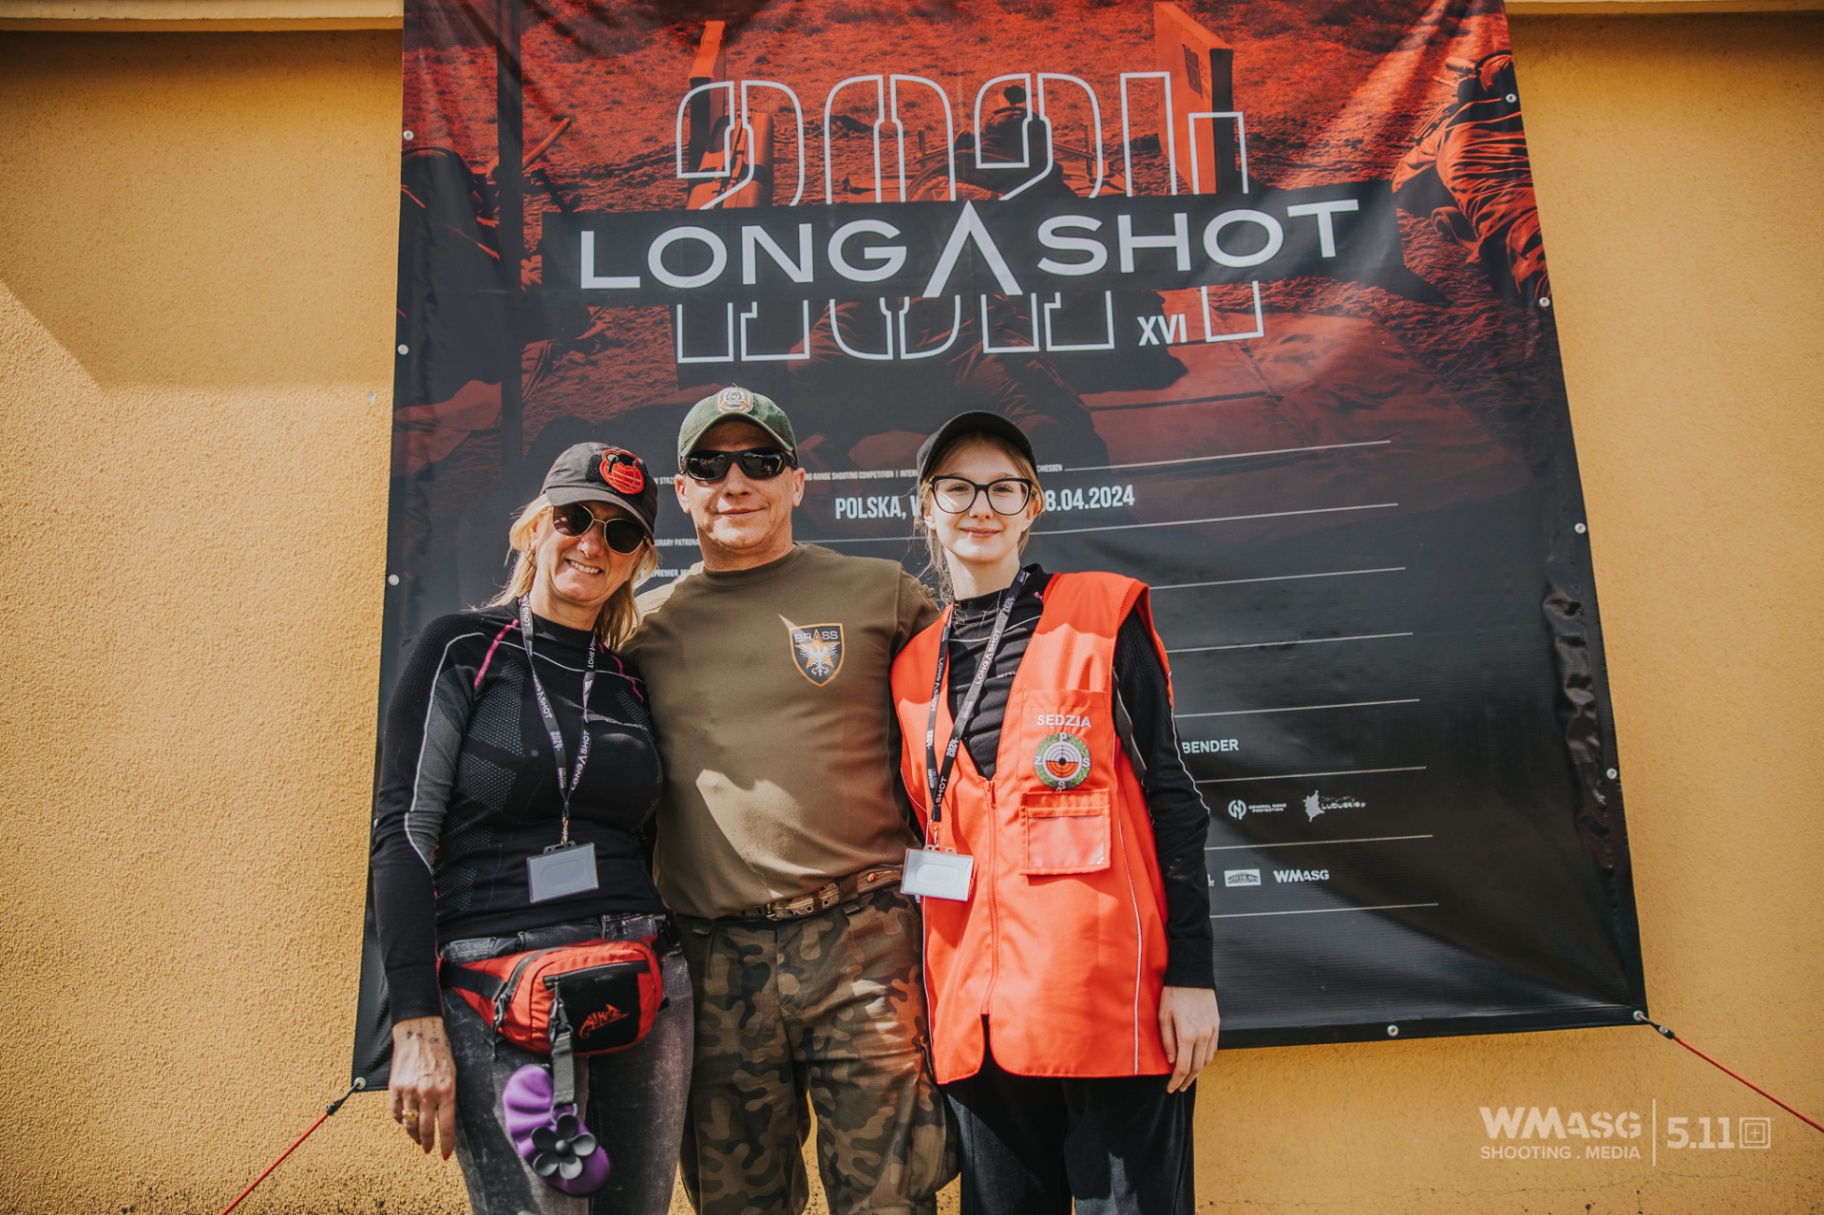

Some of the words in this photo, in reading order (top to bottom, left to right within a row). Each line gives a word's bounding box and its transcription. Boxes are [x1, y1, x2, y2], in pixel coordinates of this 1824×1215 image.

[1137, 313, 1187, 346] XVI
[813, 472, 831, 481] RANGE
[832, 471, 858, 480] SHOOTING
[859, 470, 894, 479] COMPETITION
[835, 495, 907, 520] POLSKA,
[1043, 484, 1136, 512] 8.04.2024
[1036, 713, 1092, 729] SĘDZIA
[1273, 868, 1330, 883] WMASG
